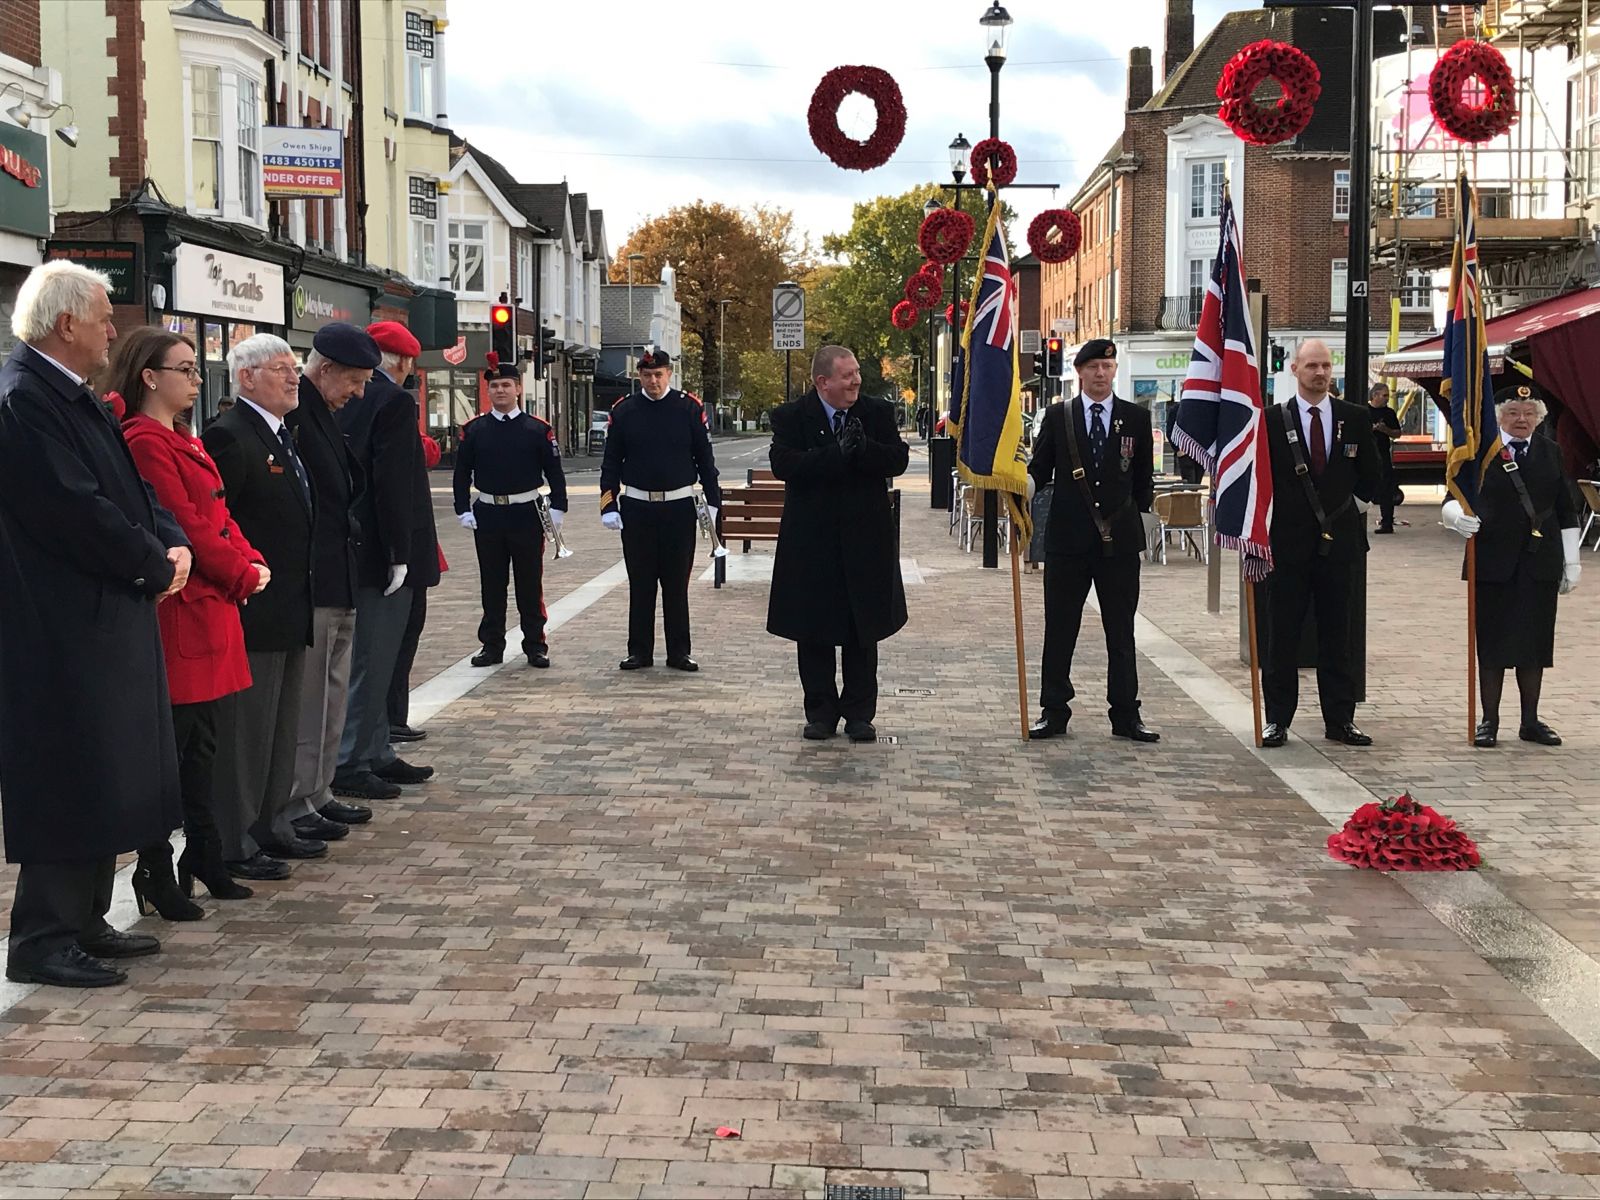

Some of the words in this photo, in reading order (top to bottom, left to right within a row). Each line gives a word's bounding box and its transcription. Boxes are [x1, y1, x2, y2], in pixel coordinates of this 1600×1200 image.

[282, 142, 306, 150] Owen
[309, 143, 333, 152] Shipp
[294, 157, 336, 168] 450115
[297, 174, 334, 186] OFFER
[1191, 231, 1219, 239] CENTRA
[222, 272, 263, 302] nails
[1354, 282, 1366, 296] 4
